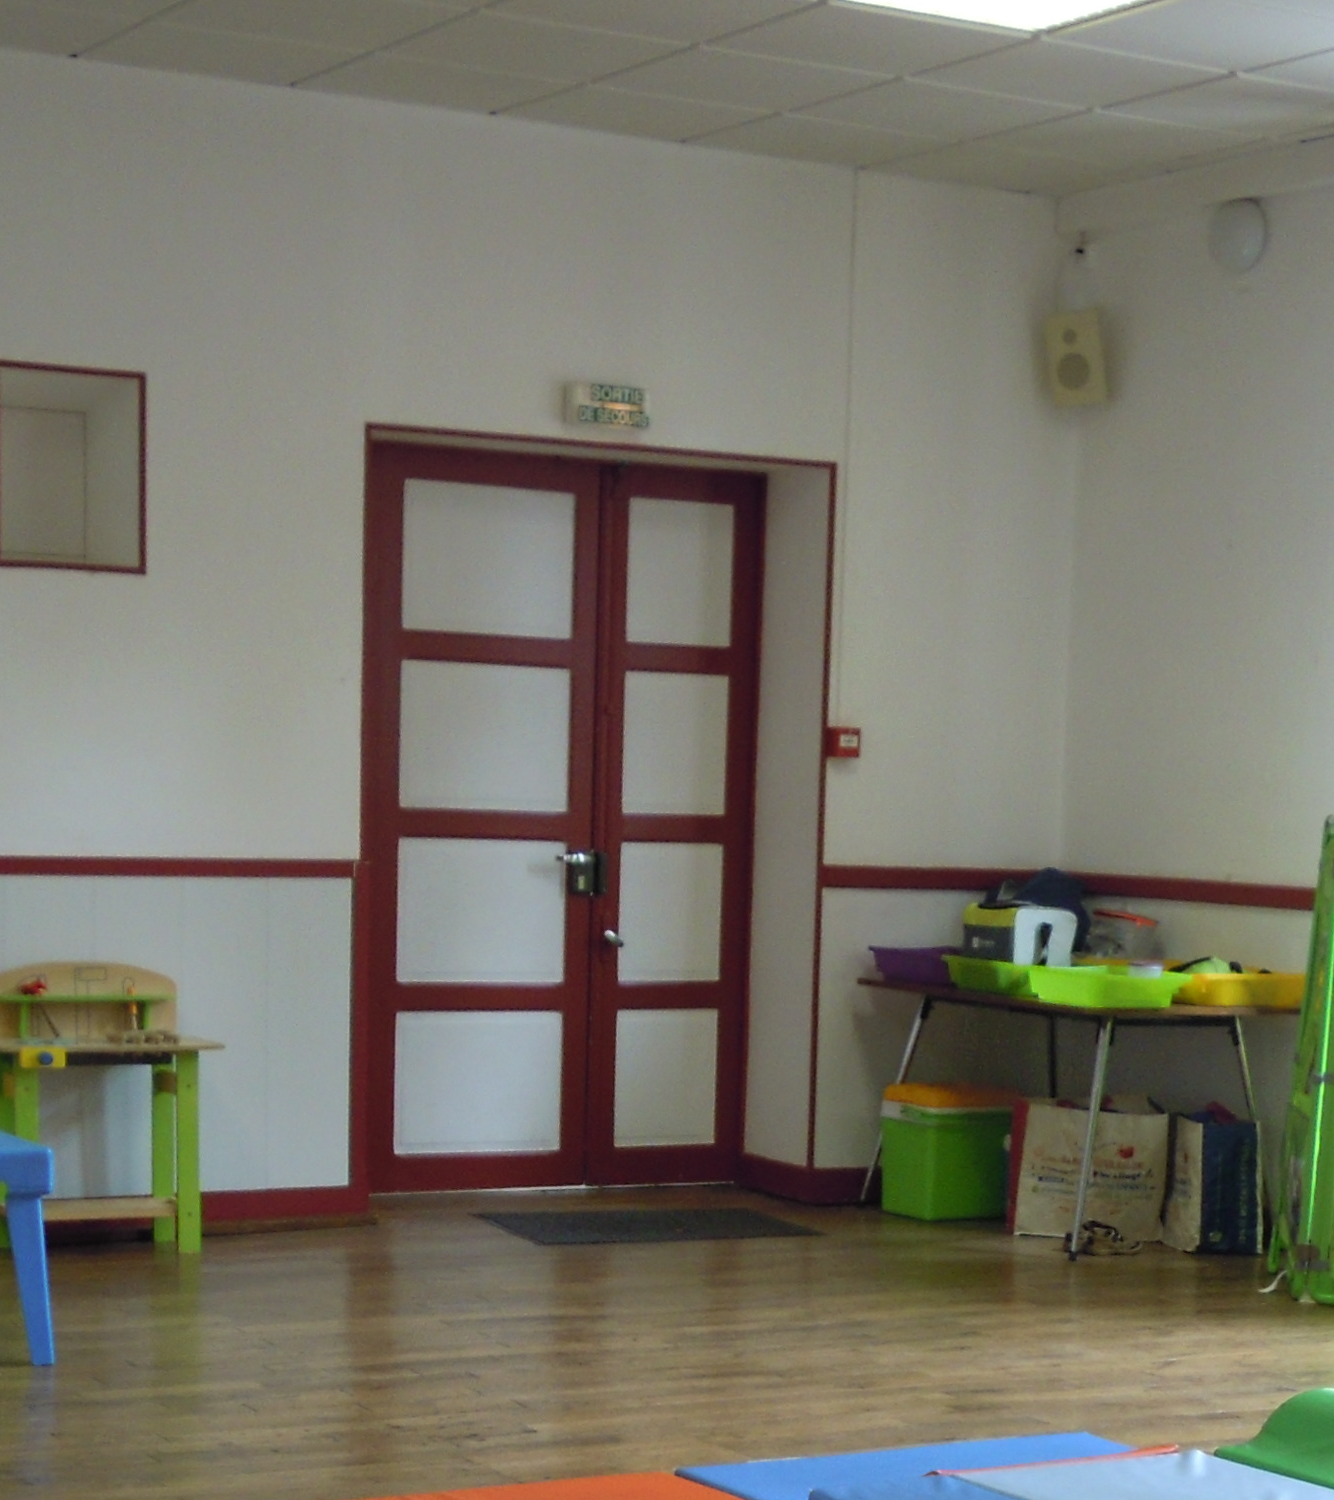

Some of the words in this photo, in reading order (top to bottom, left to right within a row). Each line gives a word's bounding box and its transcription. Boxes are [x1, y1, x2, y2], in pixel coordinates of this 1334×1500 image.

[591, 385, 644, 403] SORTIE
[579, 406, 595, 421] DE
[598, 408, 649, 426] SECOURS
